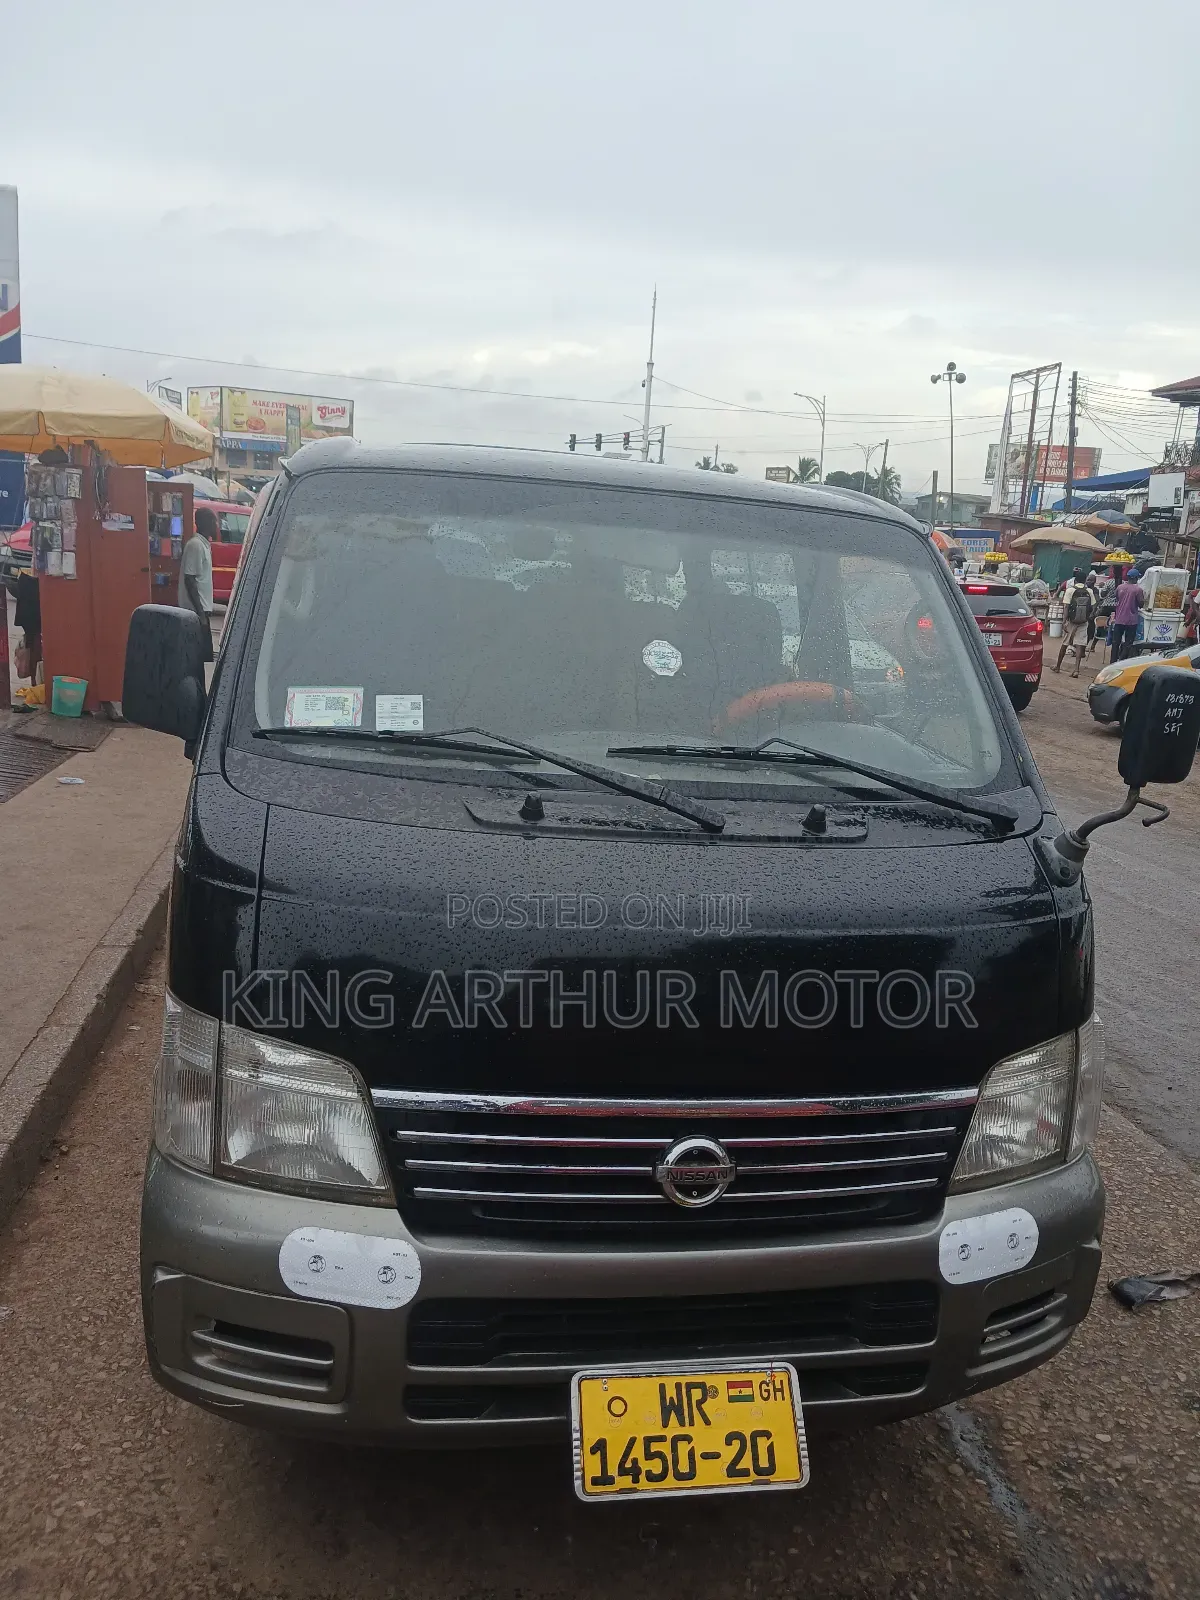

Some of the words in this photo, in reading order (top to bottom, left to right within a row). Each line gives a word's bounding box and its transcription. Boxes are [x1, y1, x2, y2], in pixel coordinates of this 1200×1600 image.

[1163, 722, 1183, 736] SET
[667, 1170, 728, 1182] NISSAN
[658, 1381, 712, 1429] WR
[758, 1380, 786, 1402] GH
[589, 1430, 777, 1487] 1450-20
